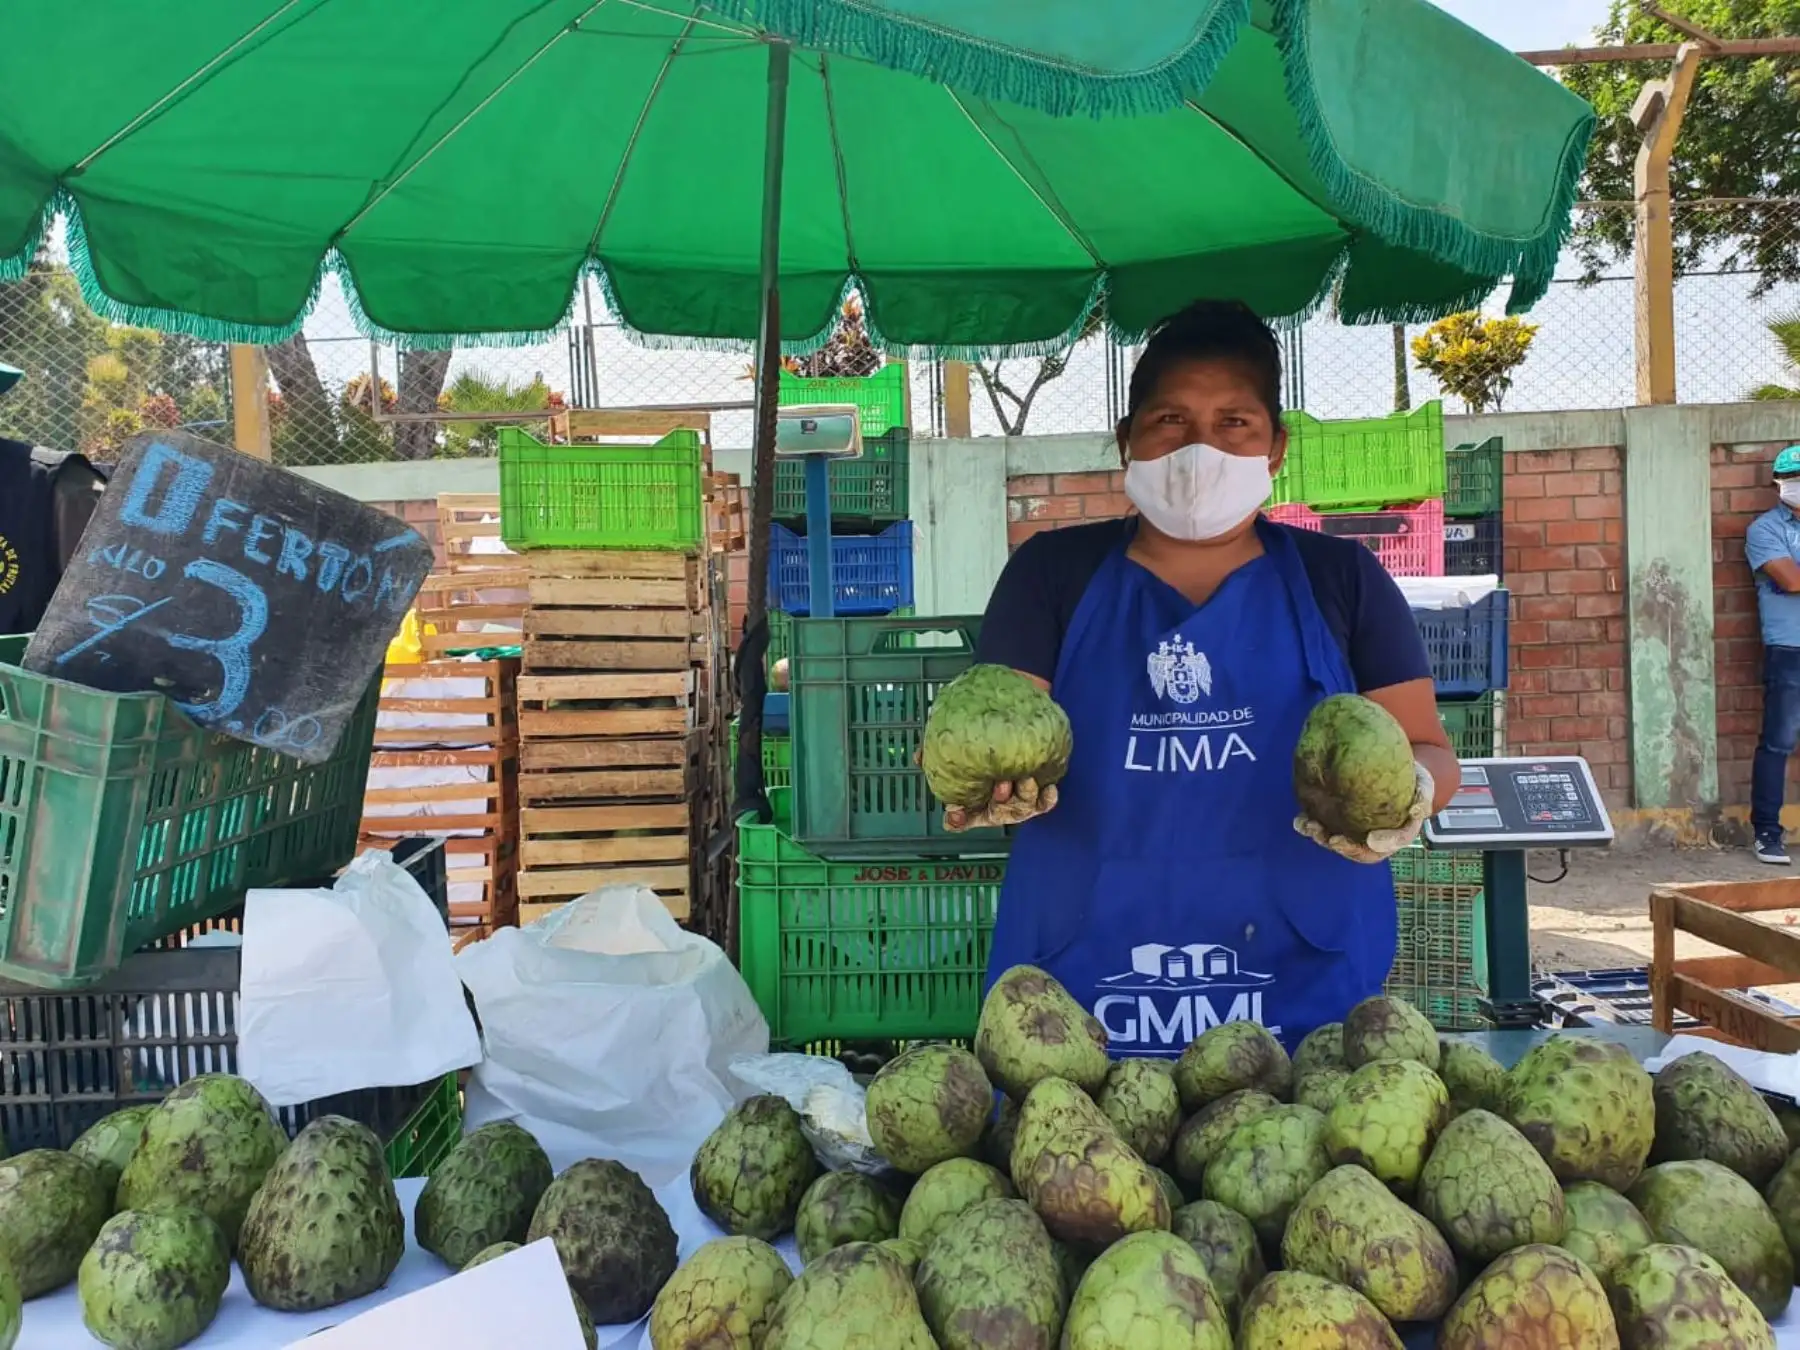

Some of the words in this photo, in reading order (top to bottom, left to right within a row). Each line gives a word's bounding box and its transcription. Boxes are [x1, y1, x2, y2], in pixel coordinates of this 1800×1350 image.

[1232, 706, 1254, 721] DE
[1124, 732, 1257, 772] LIMA
[854, 865, 912, 881] JOSE
[917, 868, 928, 881] &
[934, 864, 1002, 881] DAVID
